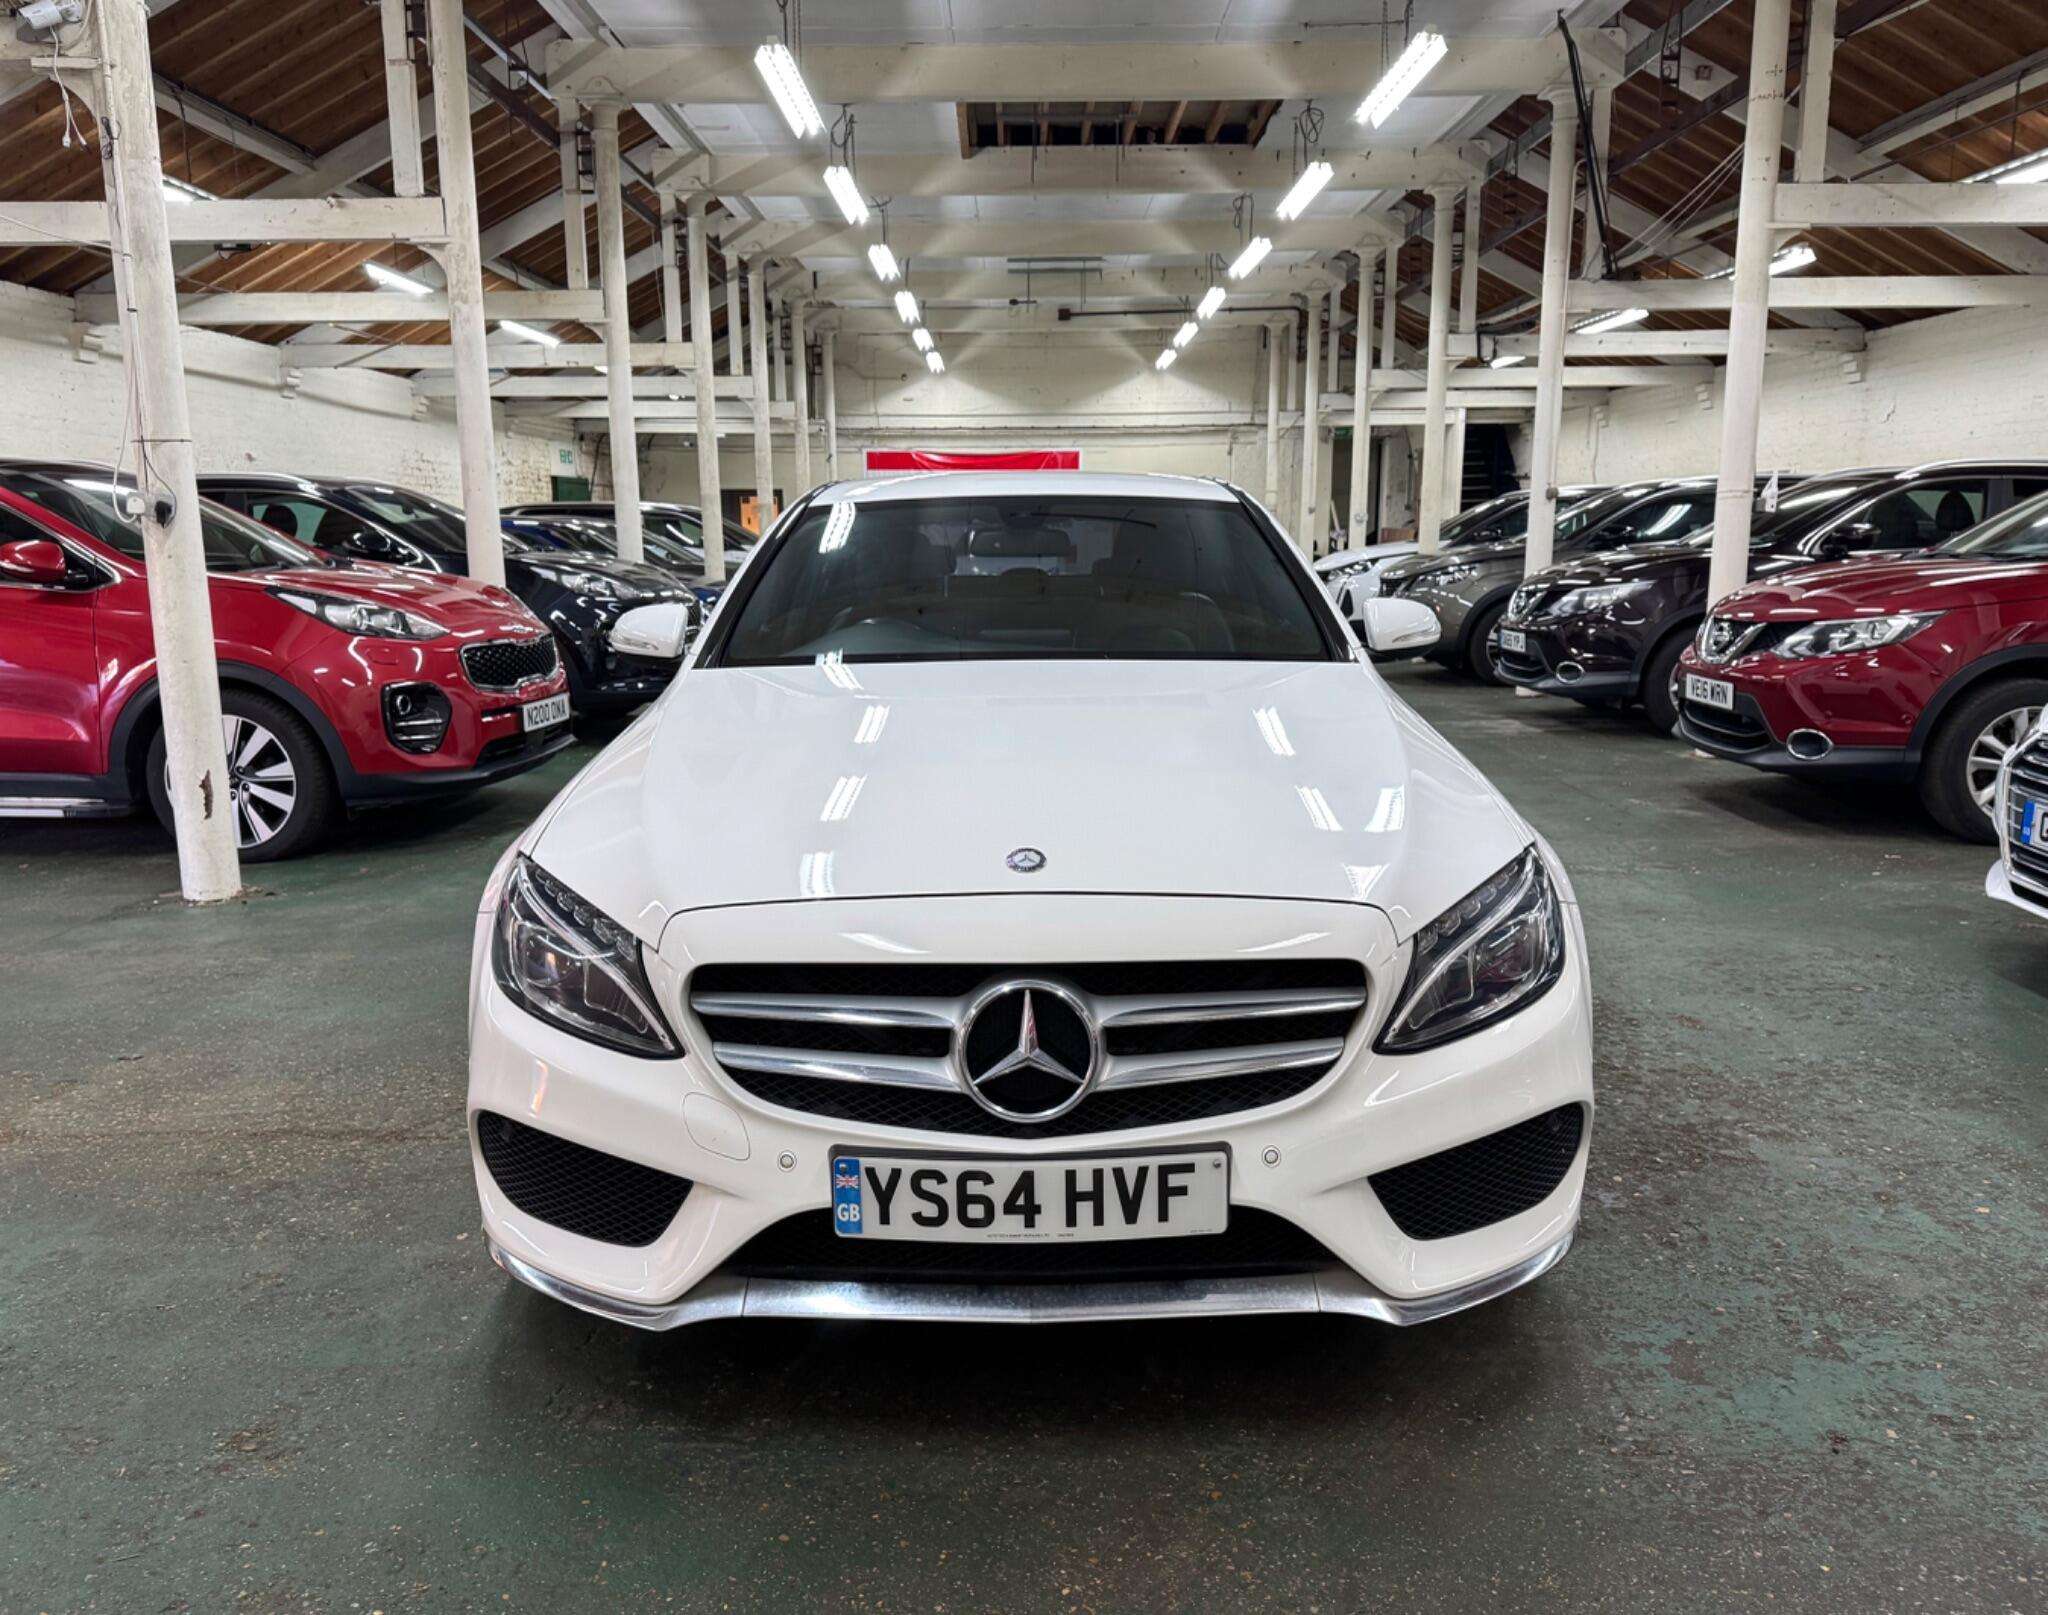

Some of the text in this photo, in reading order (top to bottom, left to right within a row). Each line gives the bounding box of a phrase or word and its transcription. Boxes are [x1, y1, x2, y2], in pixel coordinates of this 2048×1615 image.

[837, 1203, 861, 1221] GB
[865, 1162, 1196, 1229] YS64 HVF
